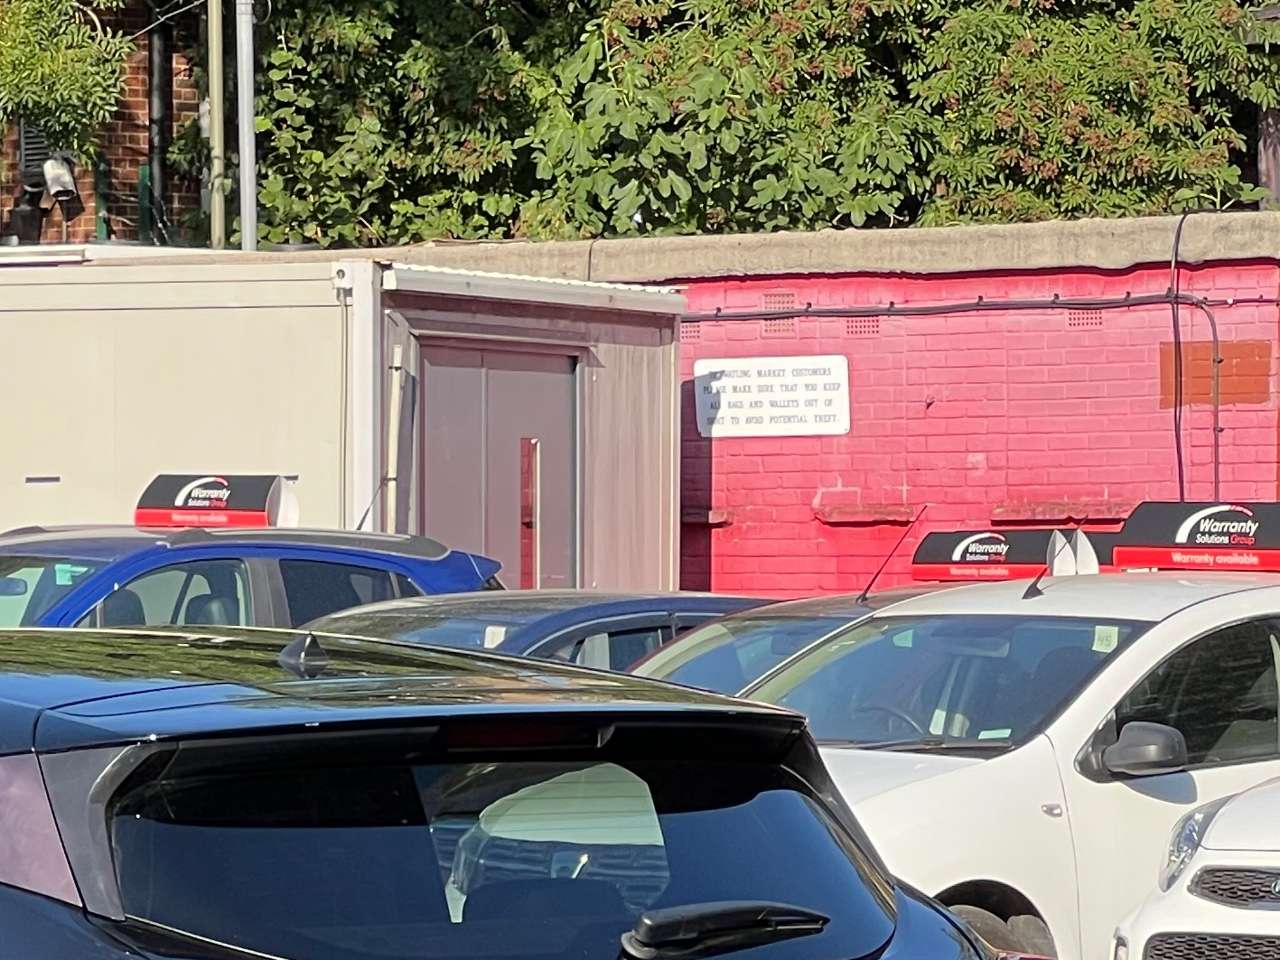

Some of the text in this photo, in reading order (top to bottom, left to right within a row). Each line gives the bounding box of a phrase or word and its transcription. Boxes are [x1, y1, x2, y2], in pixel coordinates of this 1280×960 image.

[757, 368, 786, 378] MARKET
[792, 367, 832, 377] CUSTOMERS
[732, 384, 752, 394] MAKE
[780, 383, 798, 393] THAT
[804, 383, 817, 392] YOU
[823, 382, 841, 392] KEEP
[749, 399, 764, 409] AND
[770, 399, 799, 408] WALLETS
[769, 415, 808, 425] POTENTIAL
[191, 487, 231, 500] Warranty
[1199, 518, 1259, 536] Warranty
[1195, 533, 1256, 546] Solutions Group
[968, 542, 1010, 555] Warranty
[1172, 551, 1259, 566] Warranty available
